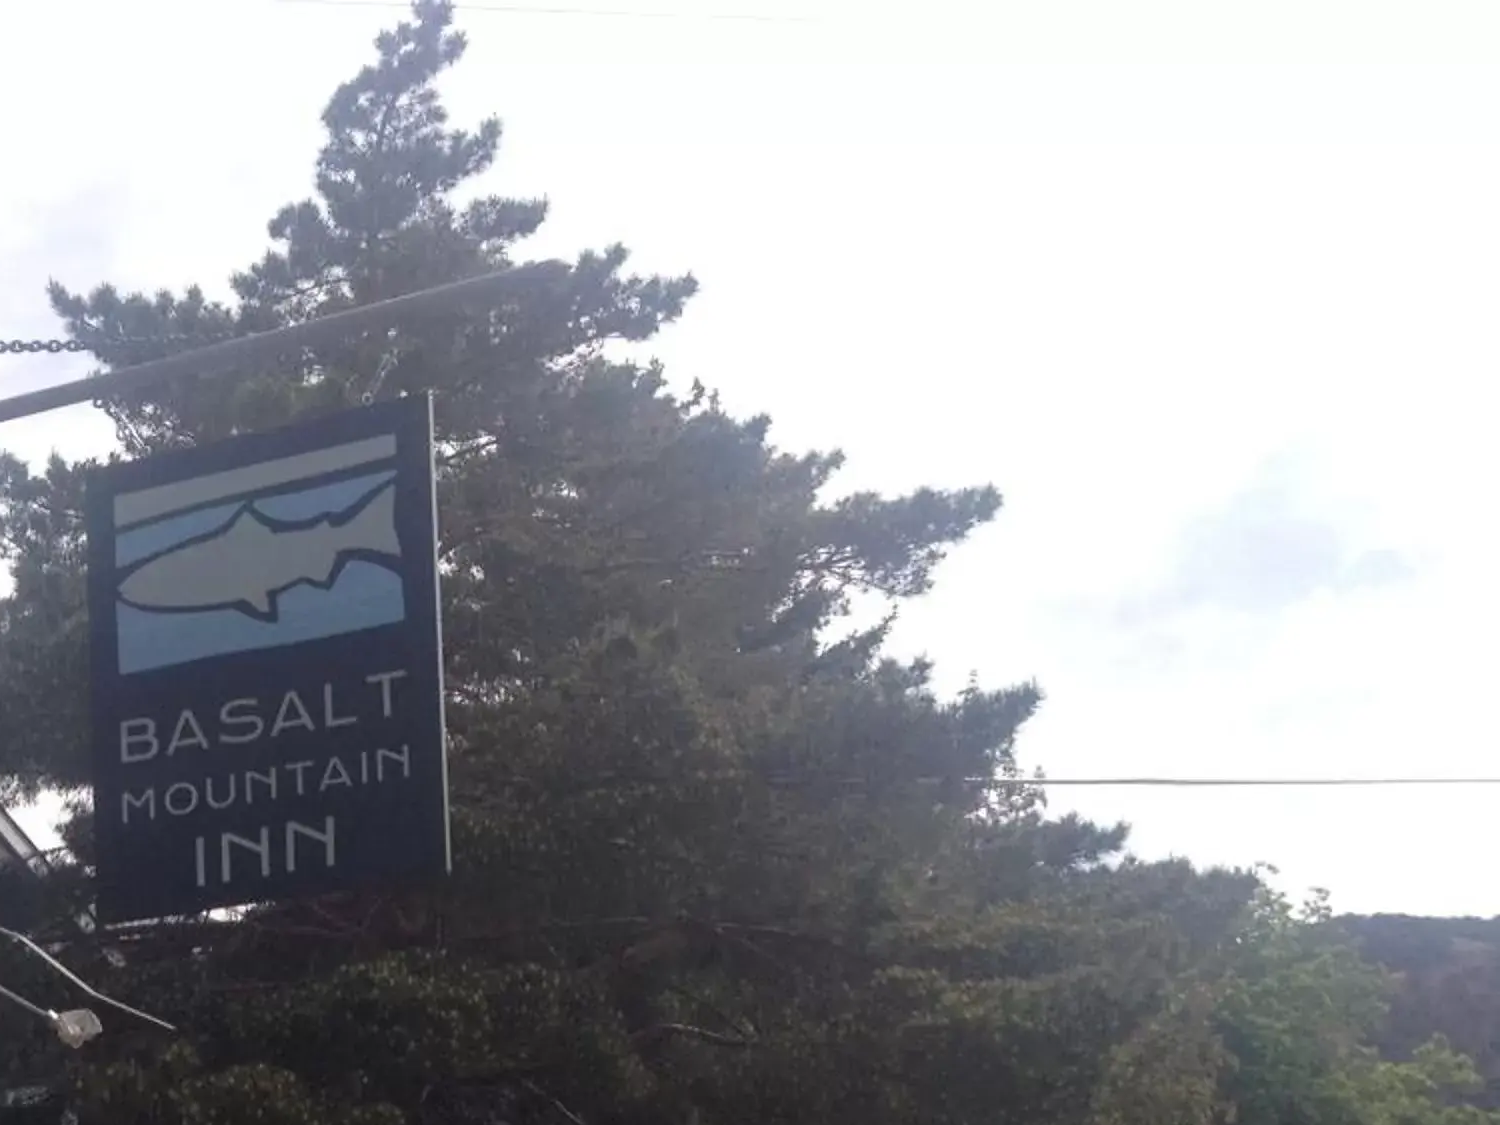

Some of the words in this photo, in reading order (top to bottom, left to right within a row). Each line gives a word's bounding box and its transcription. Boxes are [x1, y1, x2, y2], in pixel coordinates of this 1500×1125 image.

[119, 669, 408, 764] BASALT
[120, 744, 411, 824] MOUNTAIN
[195, 815, 336, 887] INN
